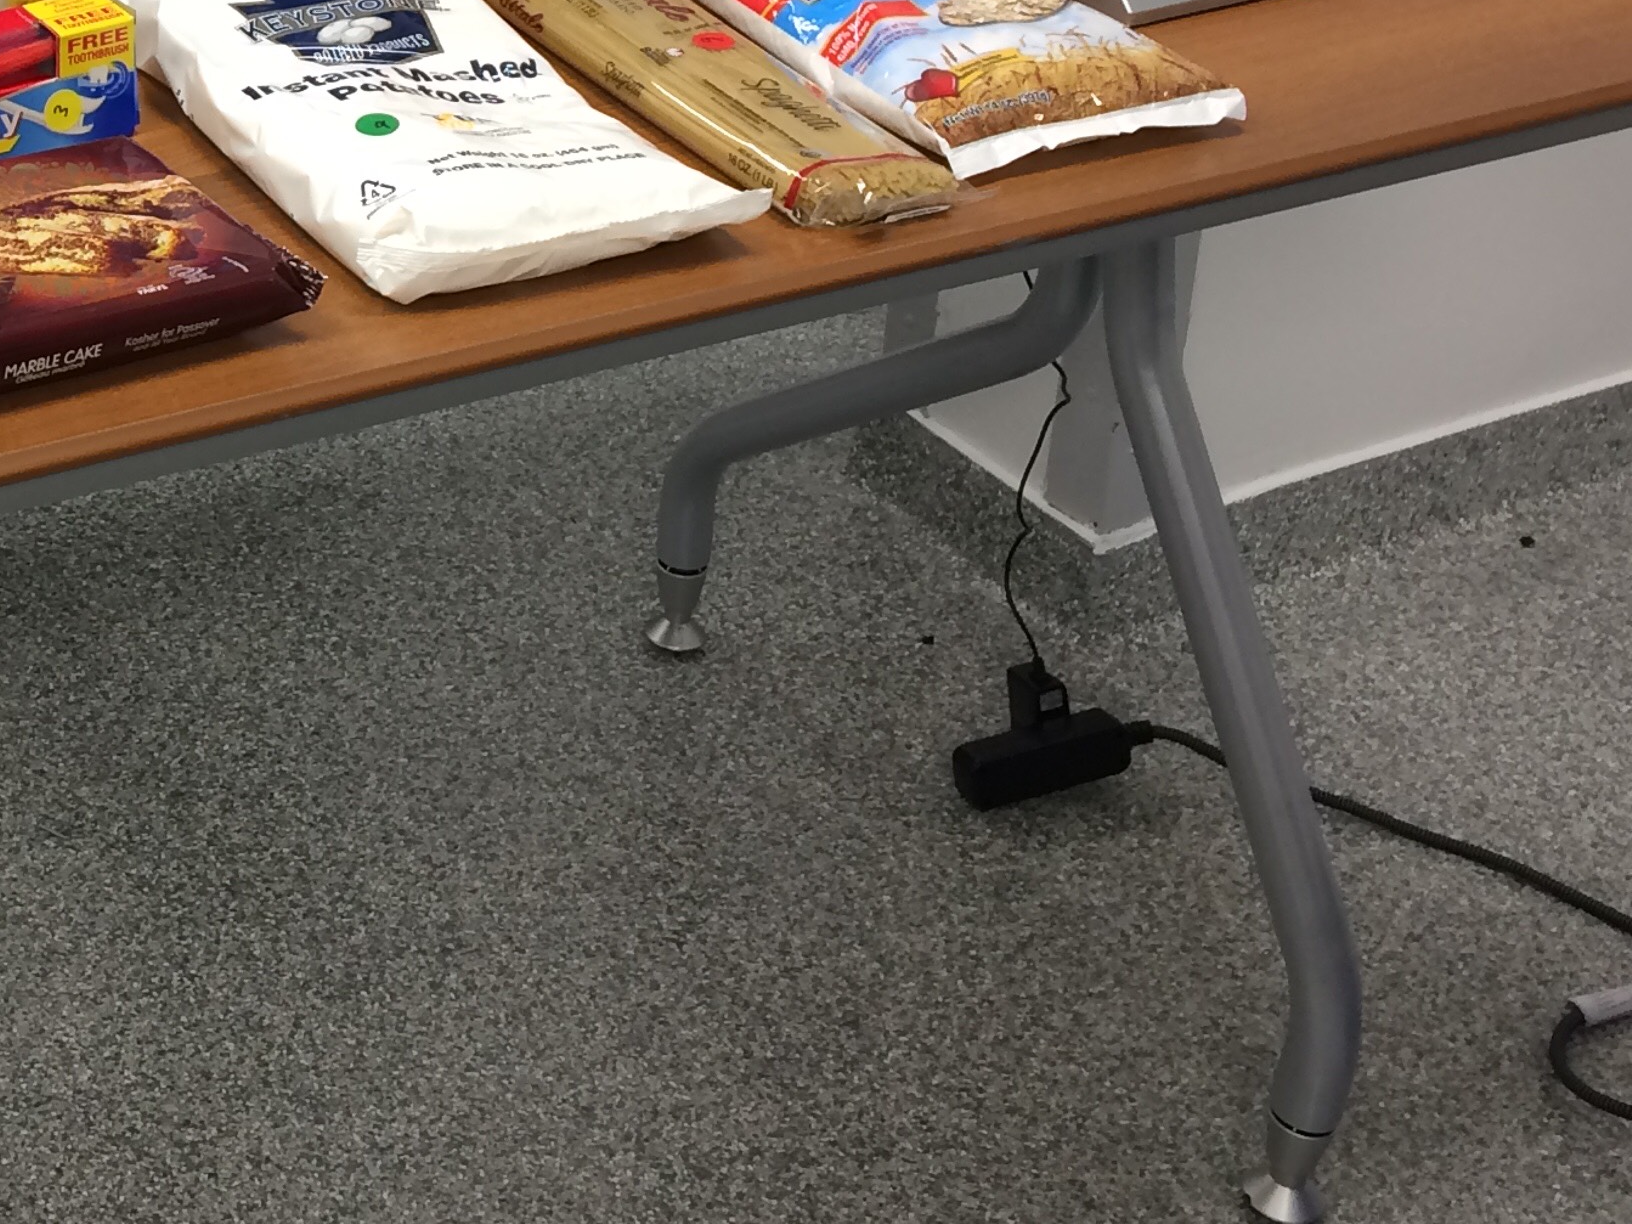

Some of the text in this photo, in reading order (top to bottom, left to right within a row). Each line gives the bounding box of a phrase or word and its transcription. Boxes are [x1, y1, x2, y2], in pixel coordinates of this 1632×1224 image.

[67, 26, 128, 54] FREE
[67, 42, 130, 66] TOOTHBRUSH
[241, 66, 390, 101] Instant
[427, 153, 456, 165] Net
[456, 150, 506, 160] Weight
[737, 159, 753, 177] OZ
[124, 332, 160, 347] Kosher
[176, 317, 220, 336] Passover
[4, 342, 105, 380] MARBLE CAKE
